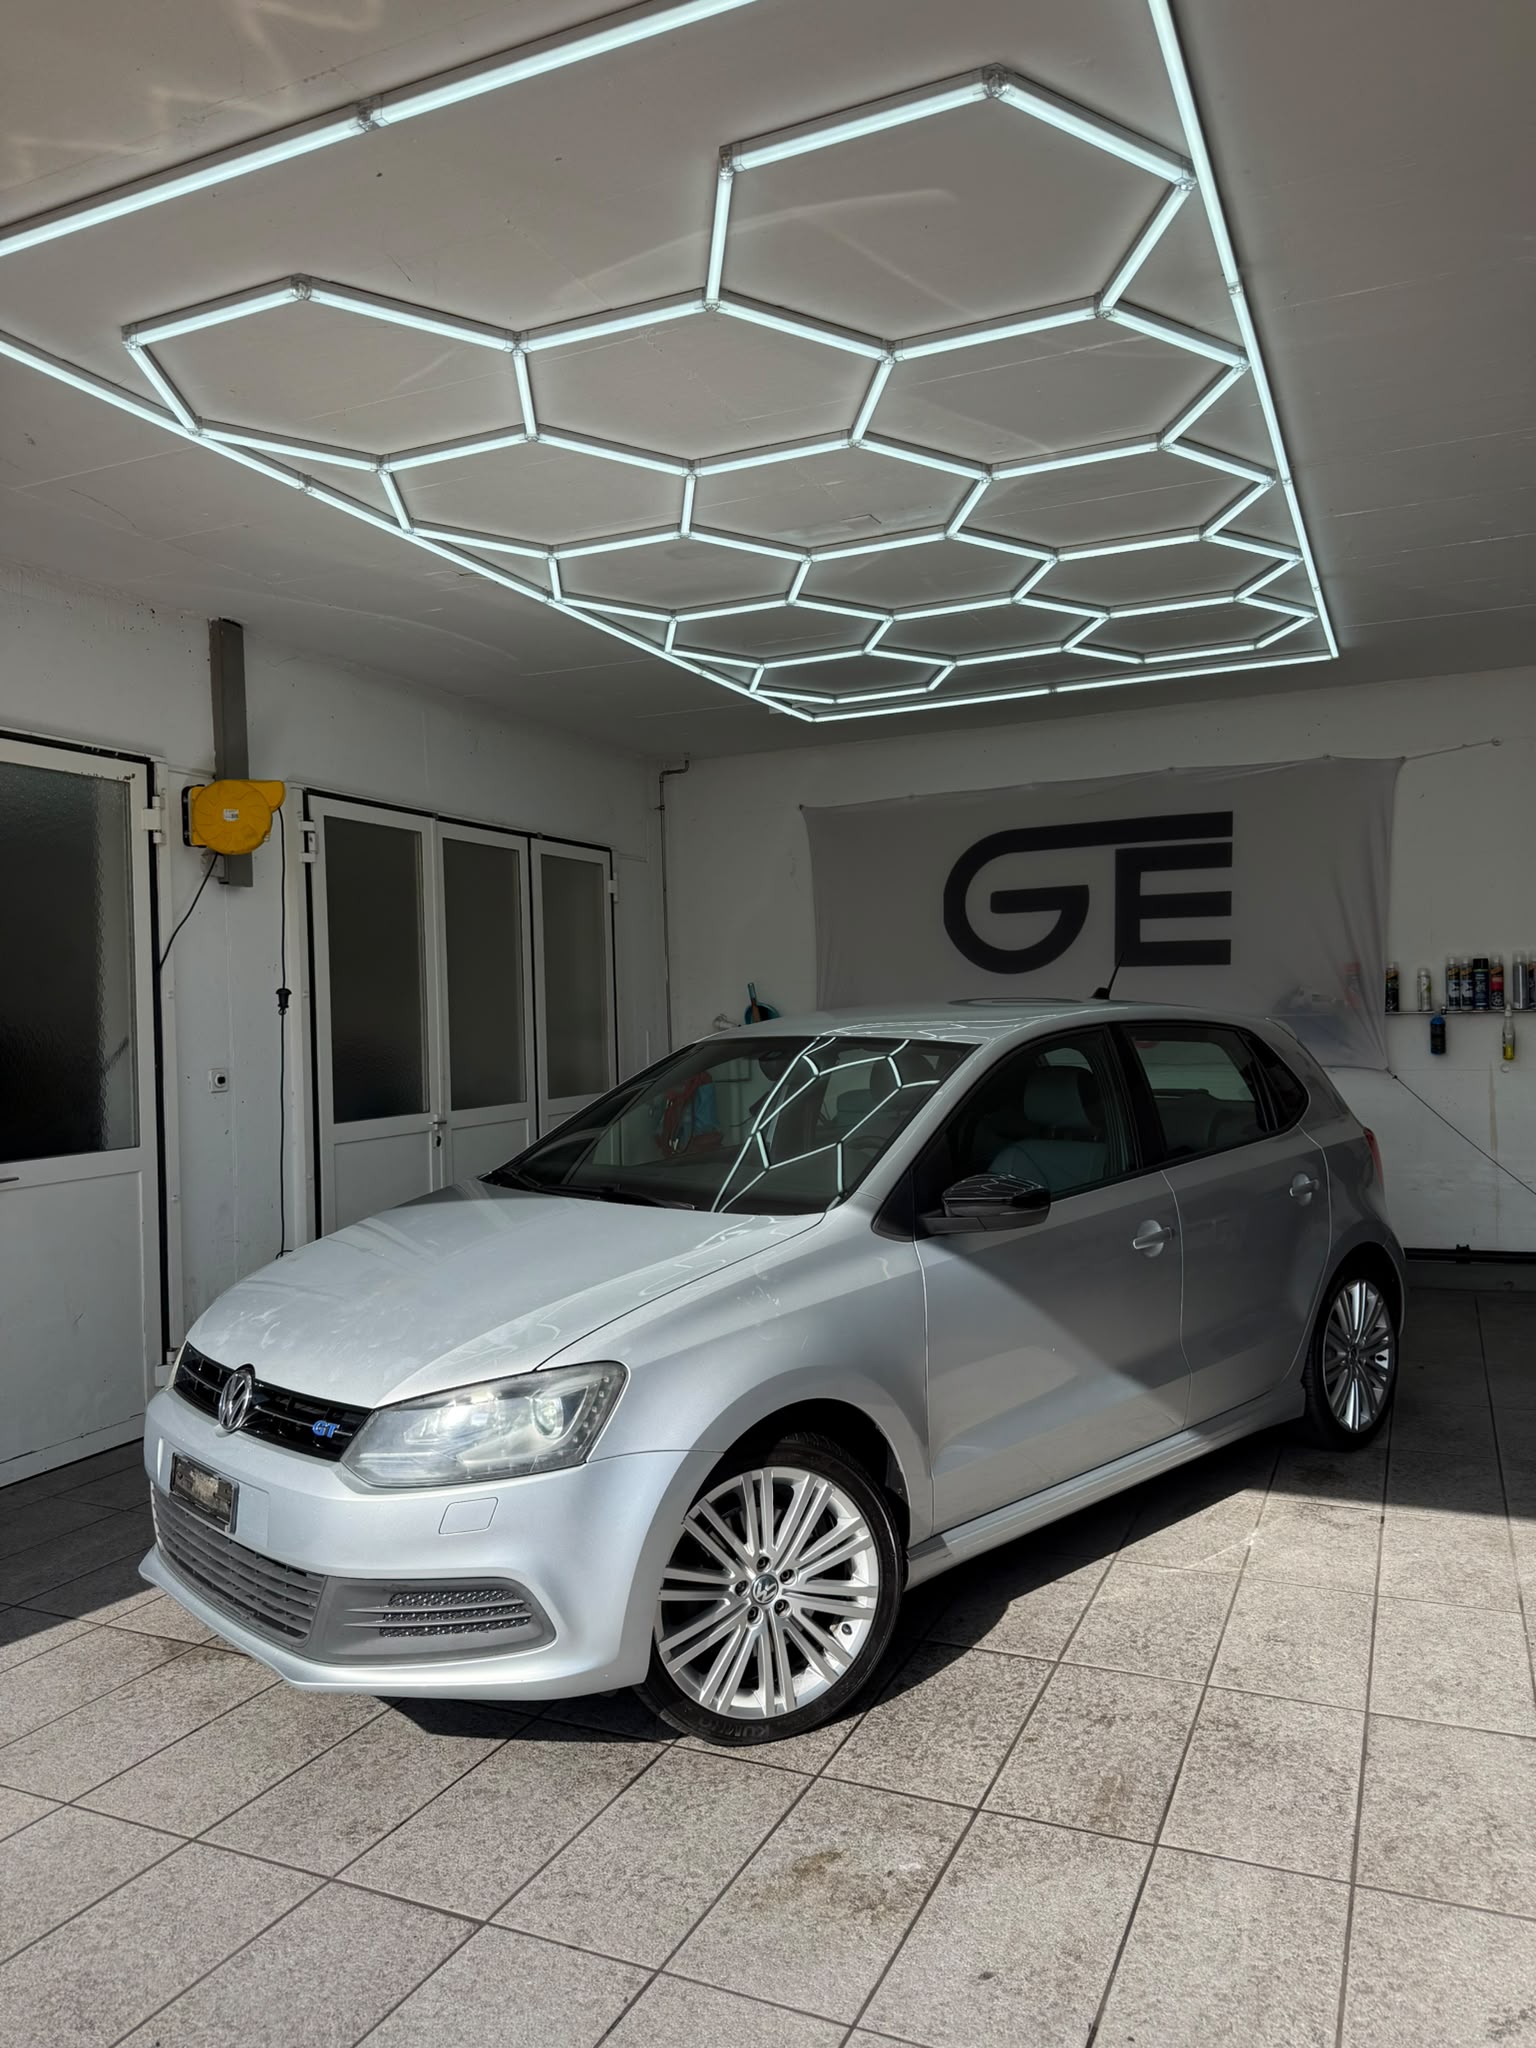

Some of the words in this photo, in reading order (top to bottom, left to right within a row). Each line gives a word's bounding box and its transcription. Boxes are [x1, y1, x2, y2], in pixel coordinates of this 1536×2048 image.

[943, 811, 1233, 974] GE
[219, 1371, 252, 1431] VW
[312, 1419, 340, 1438] GT
